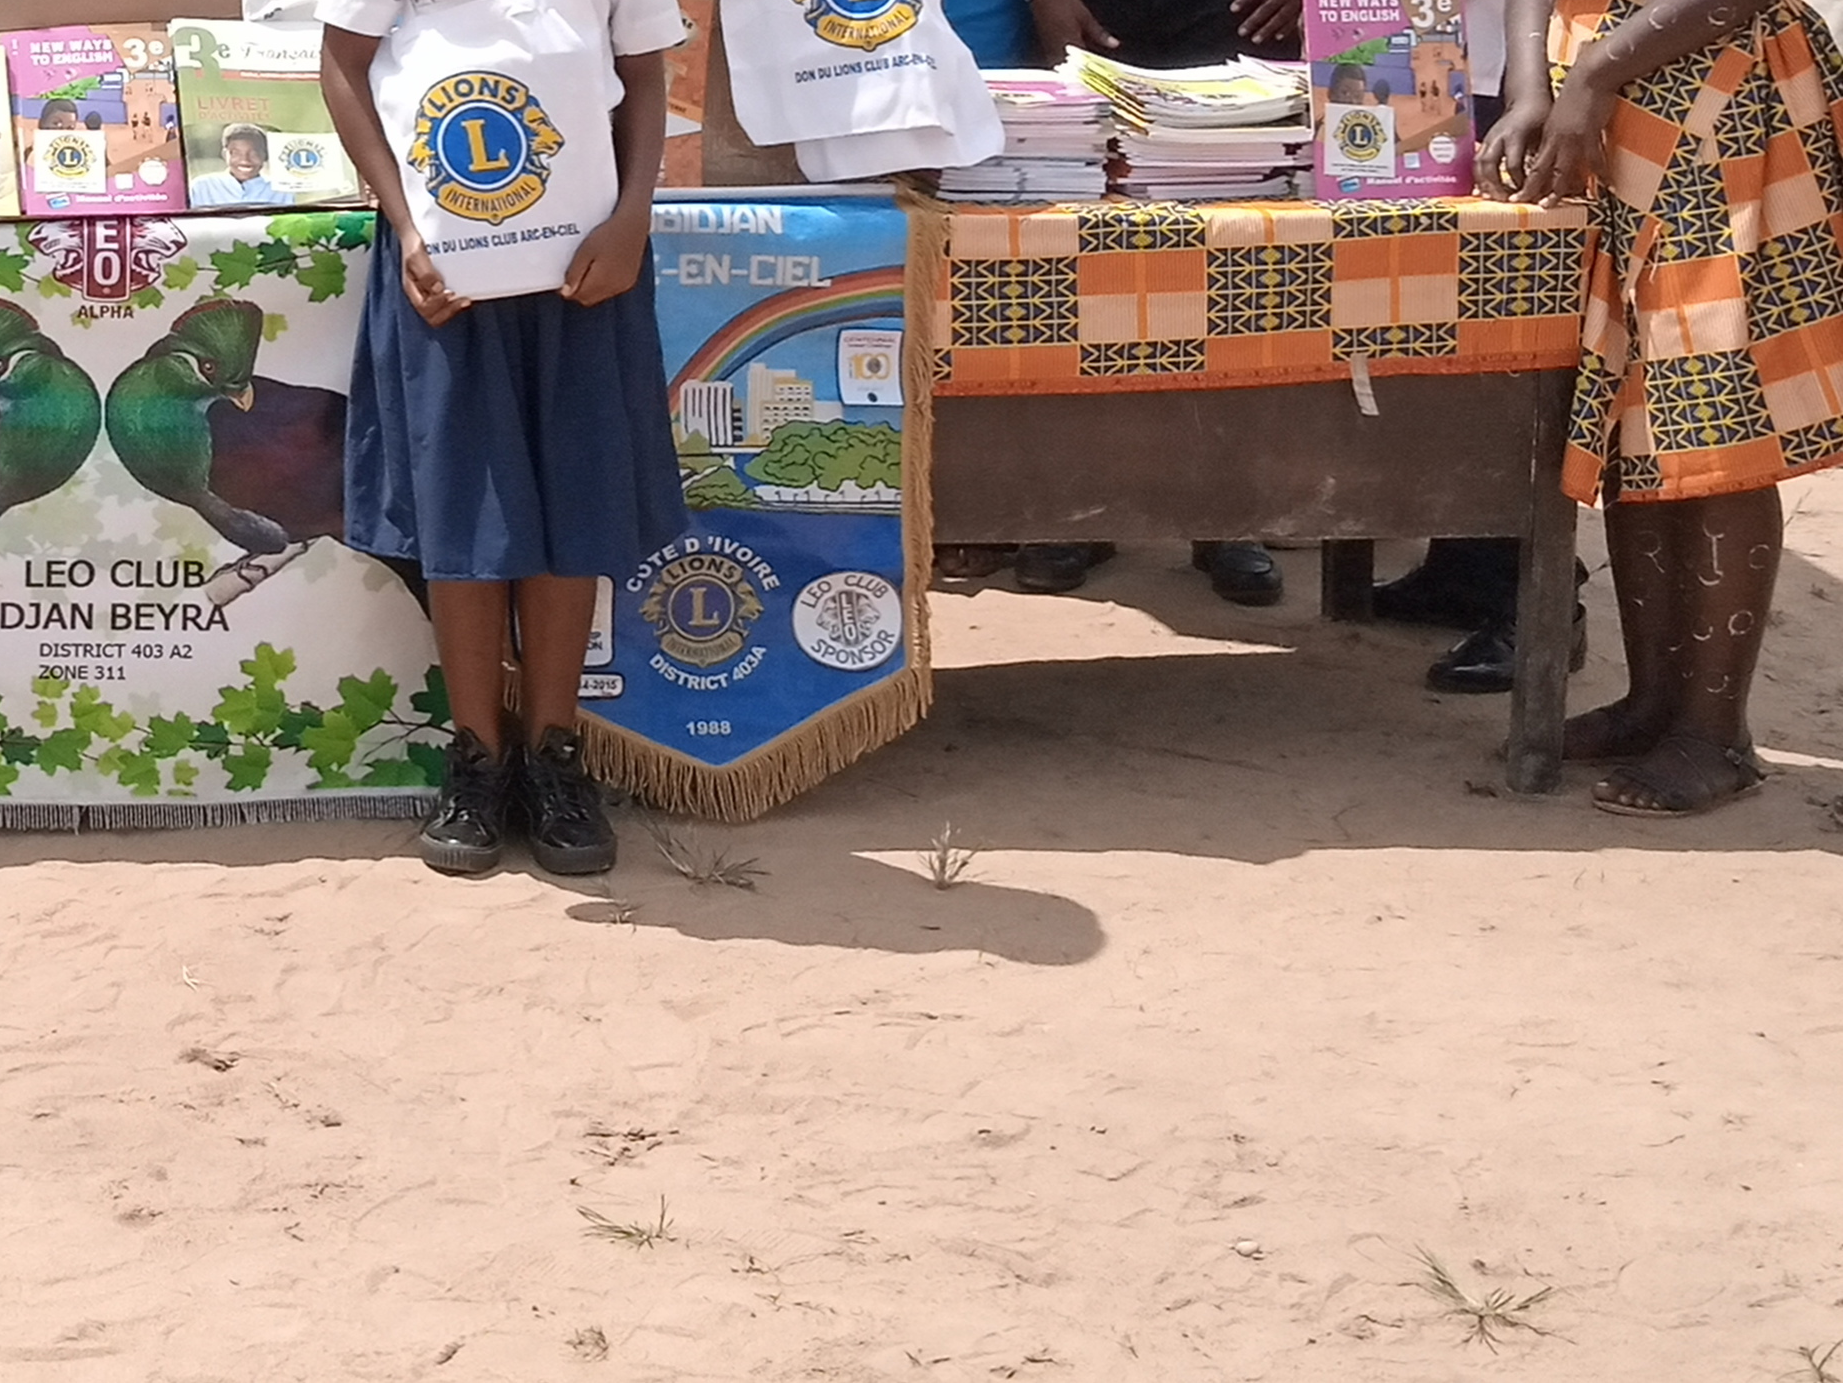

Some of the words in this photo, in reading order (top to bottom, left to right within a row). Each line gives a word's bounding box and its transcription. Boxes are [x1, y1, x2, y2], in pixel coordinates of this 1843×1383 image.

[823, 9, 911, 42] INTERNATIONAL
[1319, 10, 1340, 23] TO
[1342, 9, 1400, 22] ENGLISH
[30, 41, 64, 54] NEW
[69, 39, 112, 52] WAYS
[30, 54, 51, 66] TO
[53, 51, 114, 65] ENGLISH
[240, 41, 321, 65] Françai
[795, 69, 816, 83] DON
[817, 66, 832, 79] DU
[833, 61, 863, 77] LIONS
[864, 58, 889, 72] CLUB
[197, 96, 271, 110] LIVRET
[426, 76, 521, 114] LIONS
[460, 118, 510, 172] L
[444, 180, 538, 214] INTERNATIONAL
[93, 220, 121, 286] EO
[424, 243, 442, 256] ON
[442, 240, 458, 254] DU
[458, 236, 490, 252] LIONS
[491, 231, 518, 247] CLUB
[520, 223, 581, 243] ARC-EN-CIEL
[654, 252, 832, 288] -EN-CIEL
[77, 304, 135, 320] ALPHA
[24, 559, 95, 588] LEO
[110, 559, 206, 589] CLUB
[665, 556, 738, 582] LIONS
[800, 580, 832, 609] LEO
[844, 574, 889, 599] CLUB
[110, 602, 230, 632] BEYRA
[688, 587, 721, 627] L
[840, 592, 857, 640] LEO
[39, 643, 127, 659] DISTRICT
[131, 643, 164, 659] 403
[169, 644, 193, 659] A2
[810, 629, 895, 665] SPONSOR
[38, 665, 89, 681] ZONE
[94, 666, 126, 681] 311
[649, 653, 729, 690] DISTRICT
[733, 645, 767, 681] 403A
[685, 720, 732, 736] 1988
